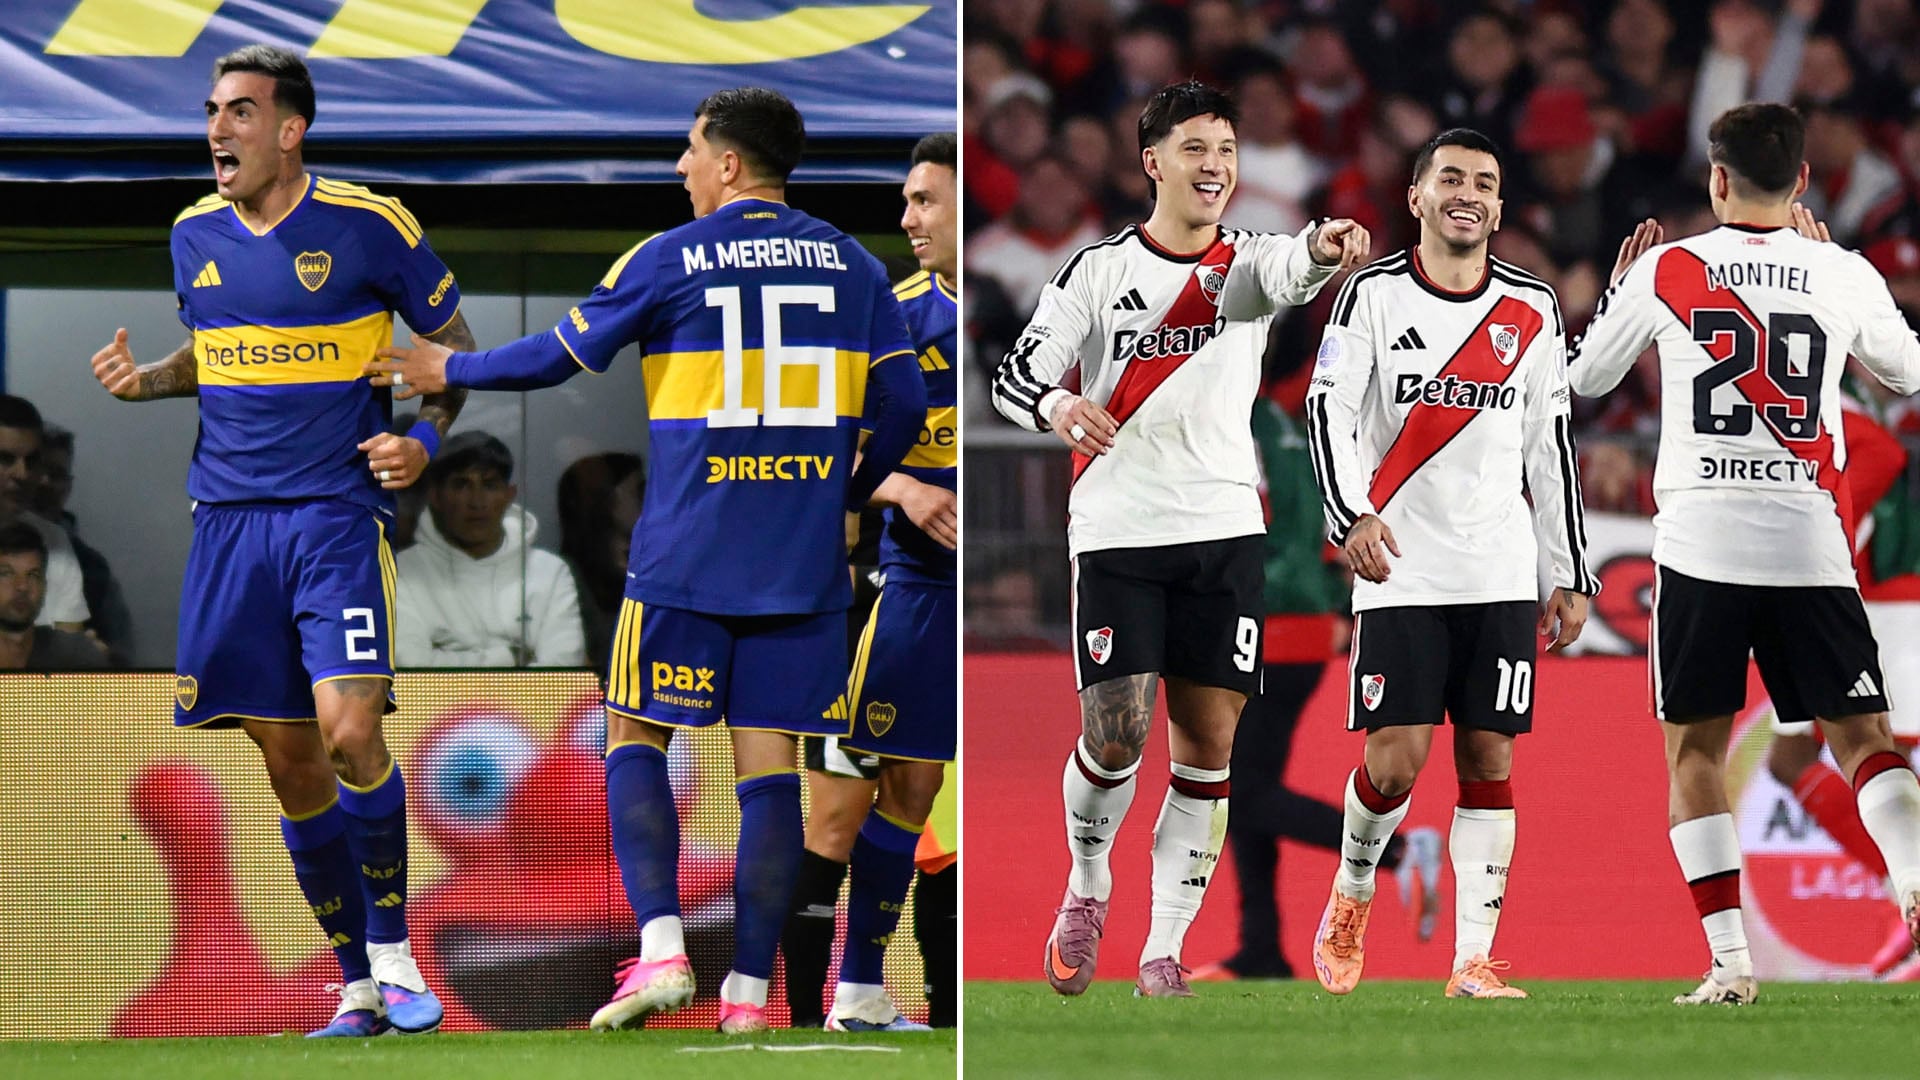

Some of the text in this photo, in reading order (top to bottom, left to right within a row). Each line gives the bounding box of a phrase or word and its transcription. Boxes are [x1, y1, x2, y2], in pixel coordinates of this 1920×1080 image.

[300, 264, 326, 273] CABJ
[682, 238, 847, 275] M. MERENTIEL
[1707, 262, 1812, 295] MONTIEL
[205, 339, 340, 368] betsson
[704, 285, 836, 428] 16
[1112, 315, 1227, 362] Betano
[1394, 373, 1516, 411] Betano
[1692, 309, 1827, 441] 29
[706, 456, 834, 484] DIRECTV
[1700, 456, 1819, 483] DIRECTV
[342, 607, 378, 661] 2
[1233, 616, 1259, 673] 9
[652, 661, 715, 693] pax
[1495, 657, 1532, 715] 10
[653, 692, 714, 709] assistance
